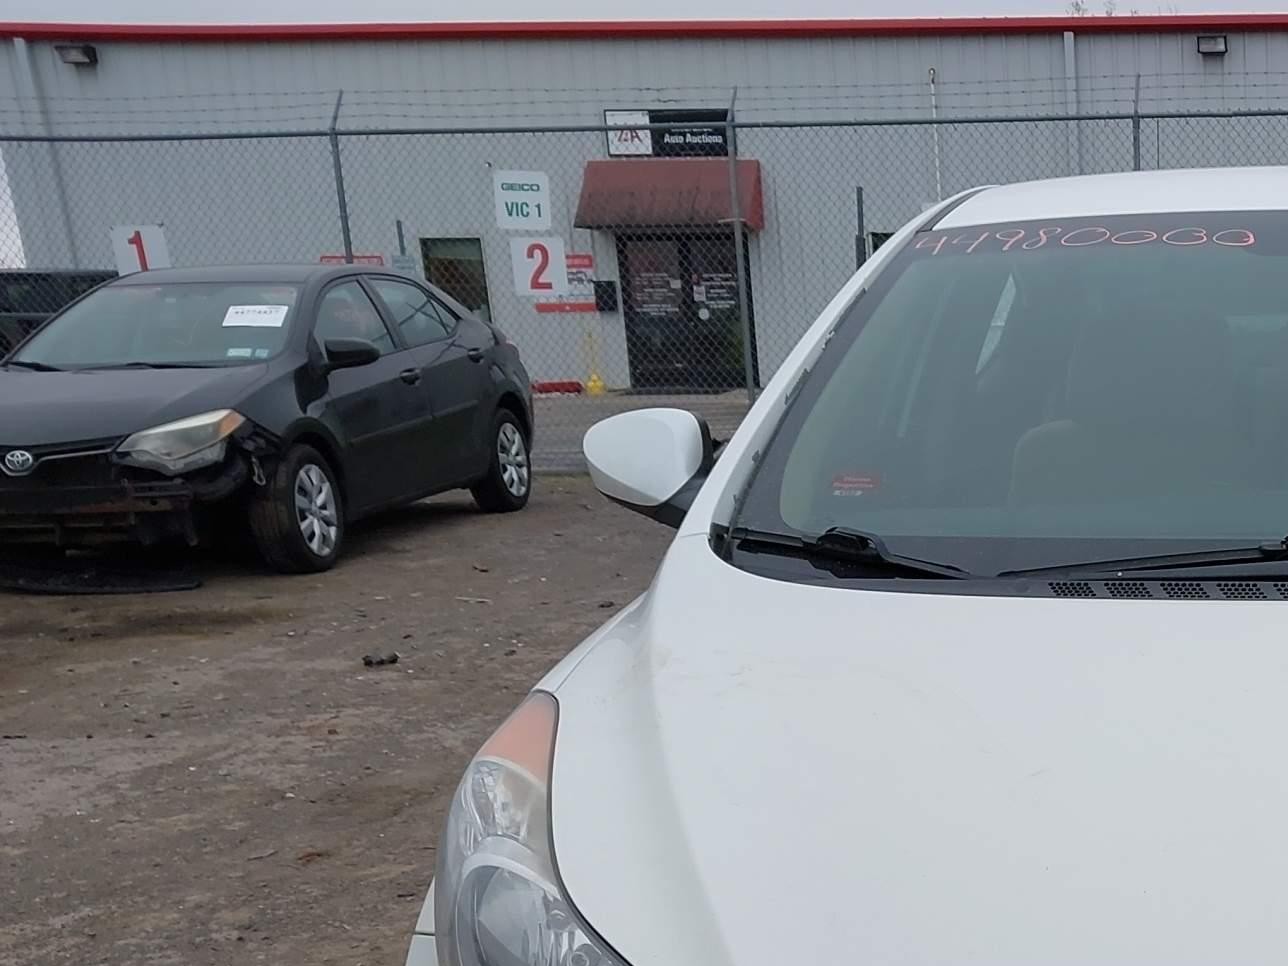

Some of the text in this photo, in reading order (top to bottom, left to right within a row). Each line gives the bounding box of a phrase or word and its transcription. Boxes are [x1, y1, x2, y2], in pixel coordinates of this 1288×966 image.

[663, 132, 723, 144] Auto Auctions
[500, 182, 540, 192] GEICO
[505, 201, 542, 218] VIC 1
[127, 230, 148, 272] 1
[914, 227, 1255, 255] 44980000
[525, 242, 553, 290] 2
